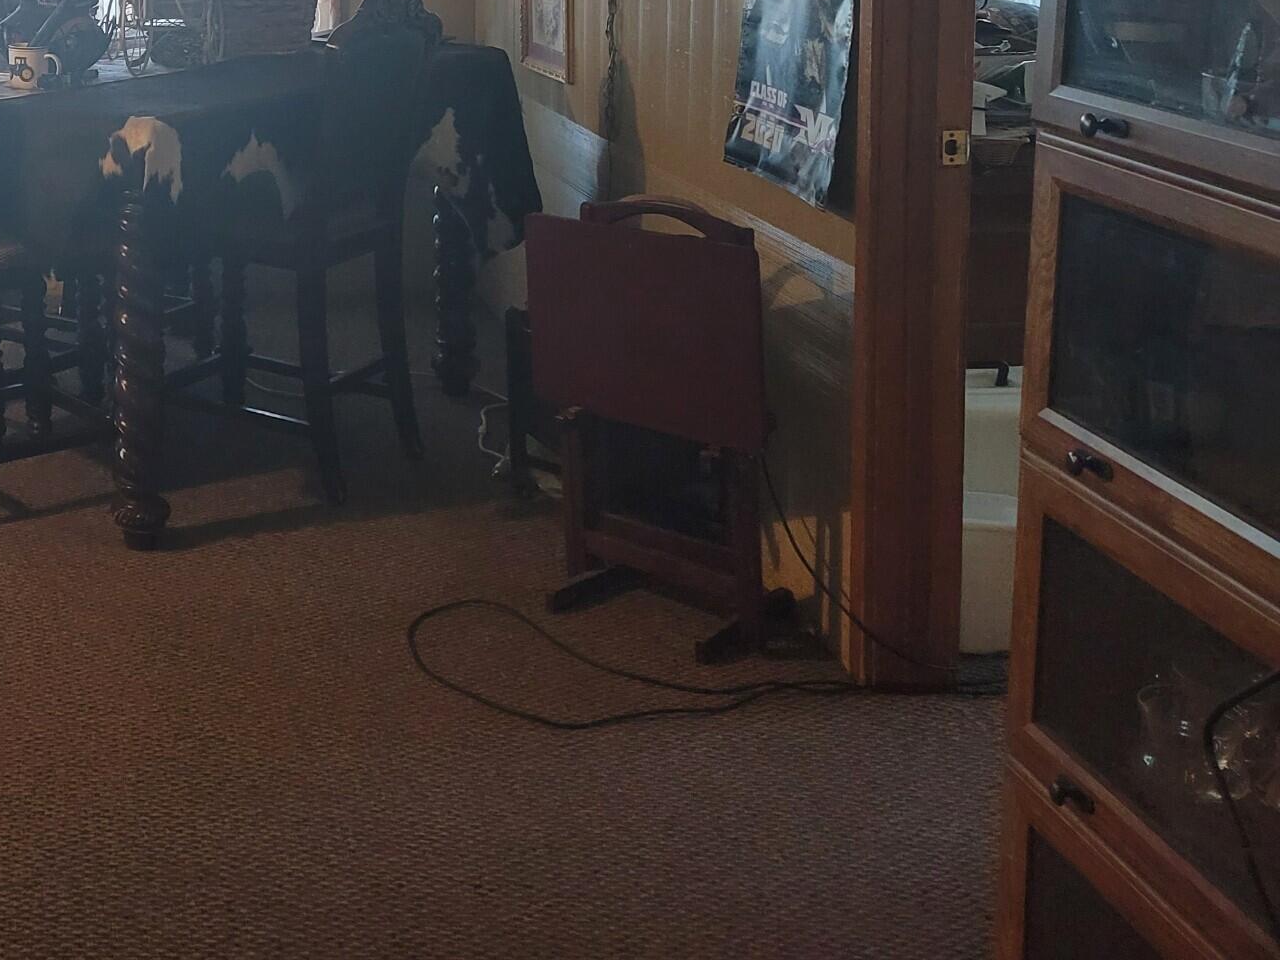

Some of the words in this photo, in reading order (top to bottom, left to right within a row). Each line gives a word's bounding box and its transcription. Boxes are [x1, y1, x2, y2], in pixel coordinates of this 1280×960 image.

[749, 80, 777, 105] CLASS
[777, 90, 788, 109] OF
[740, 111, 785, 153] 2020
